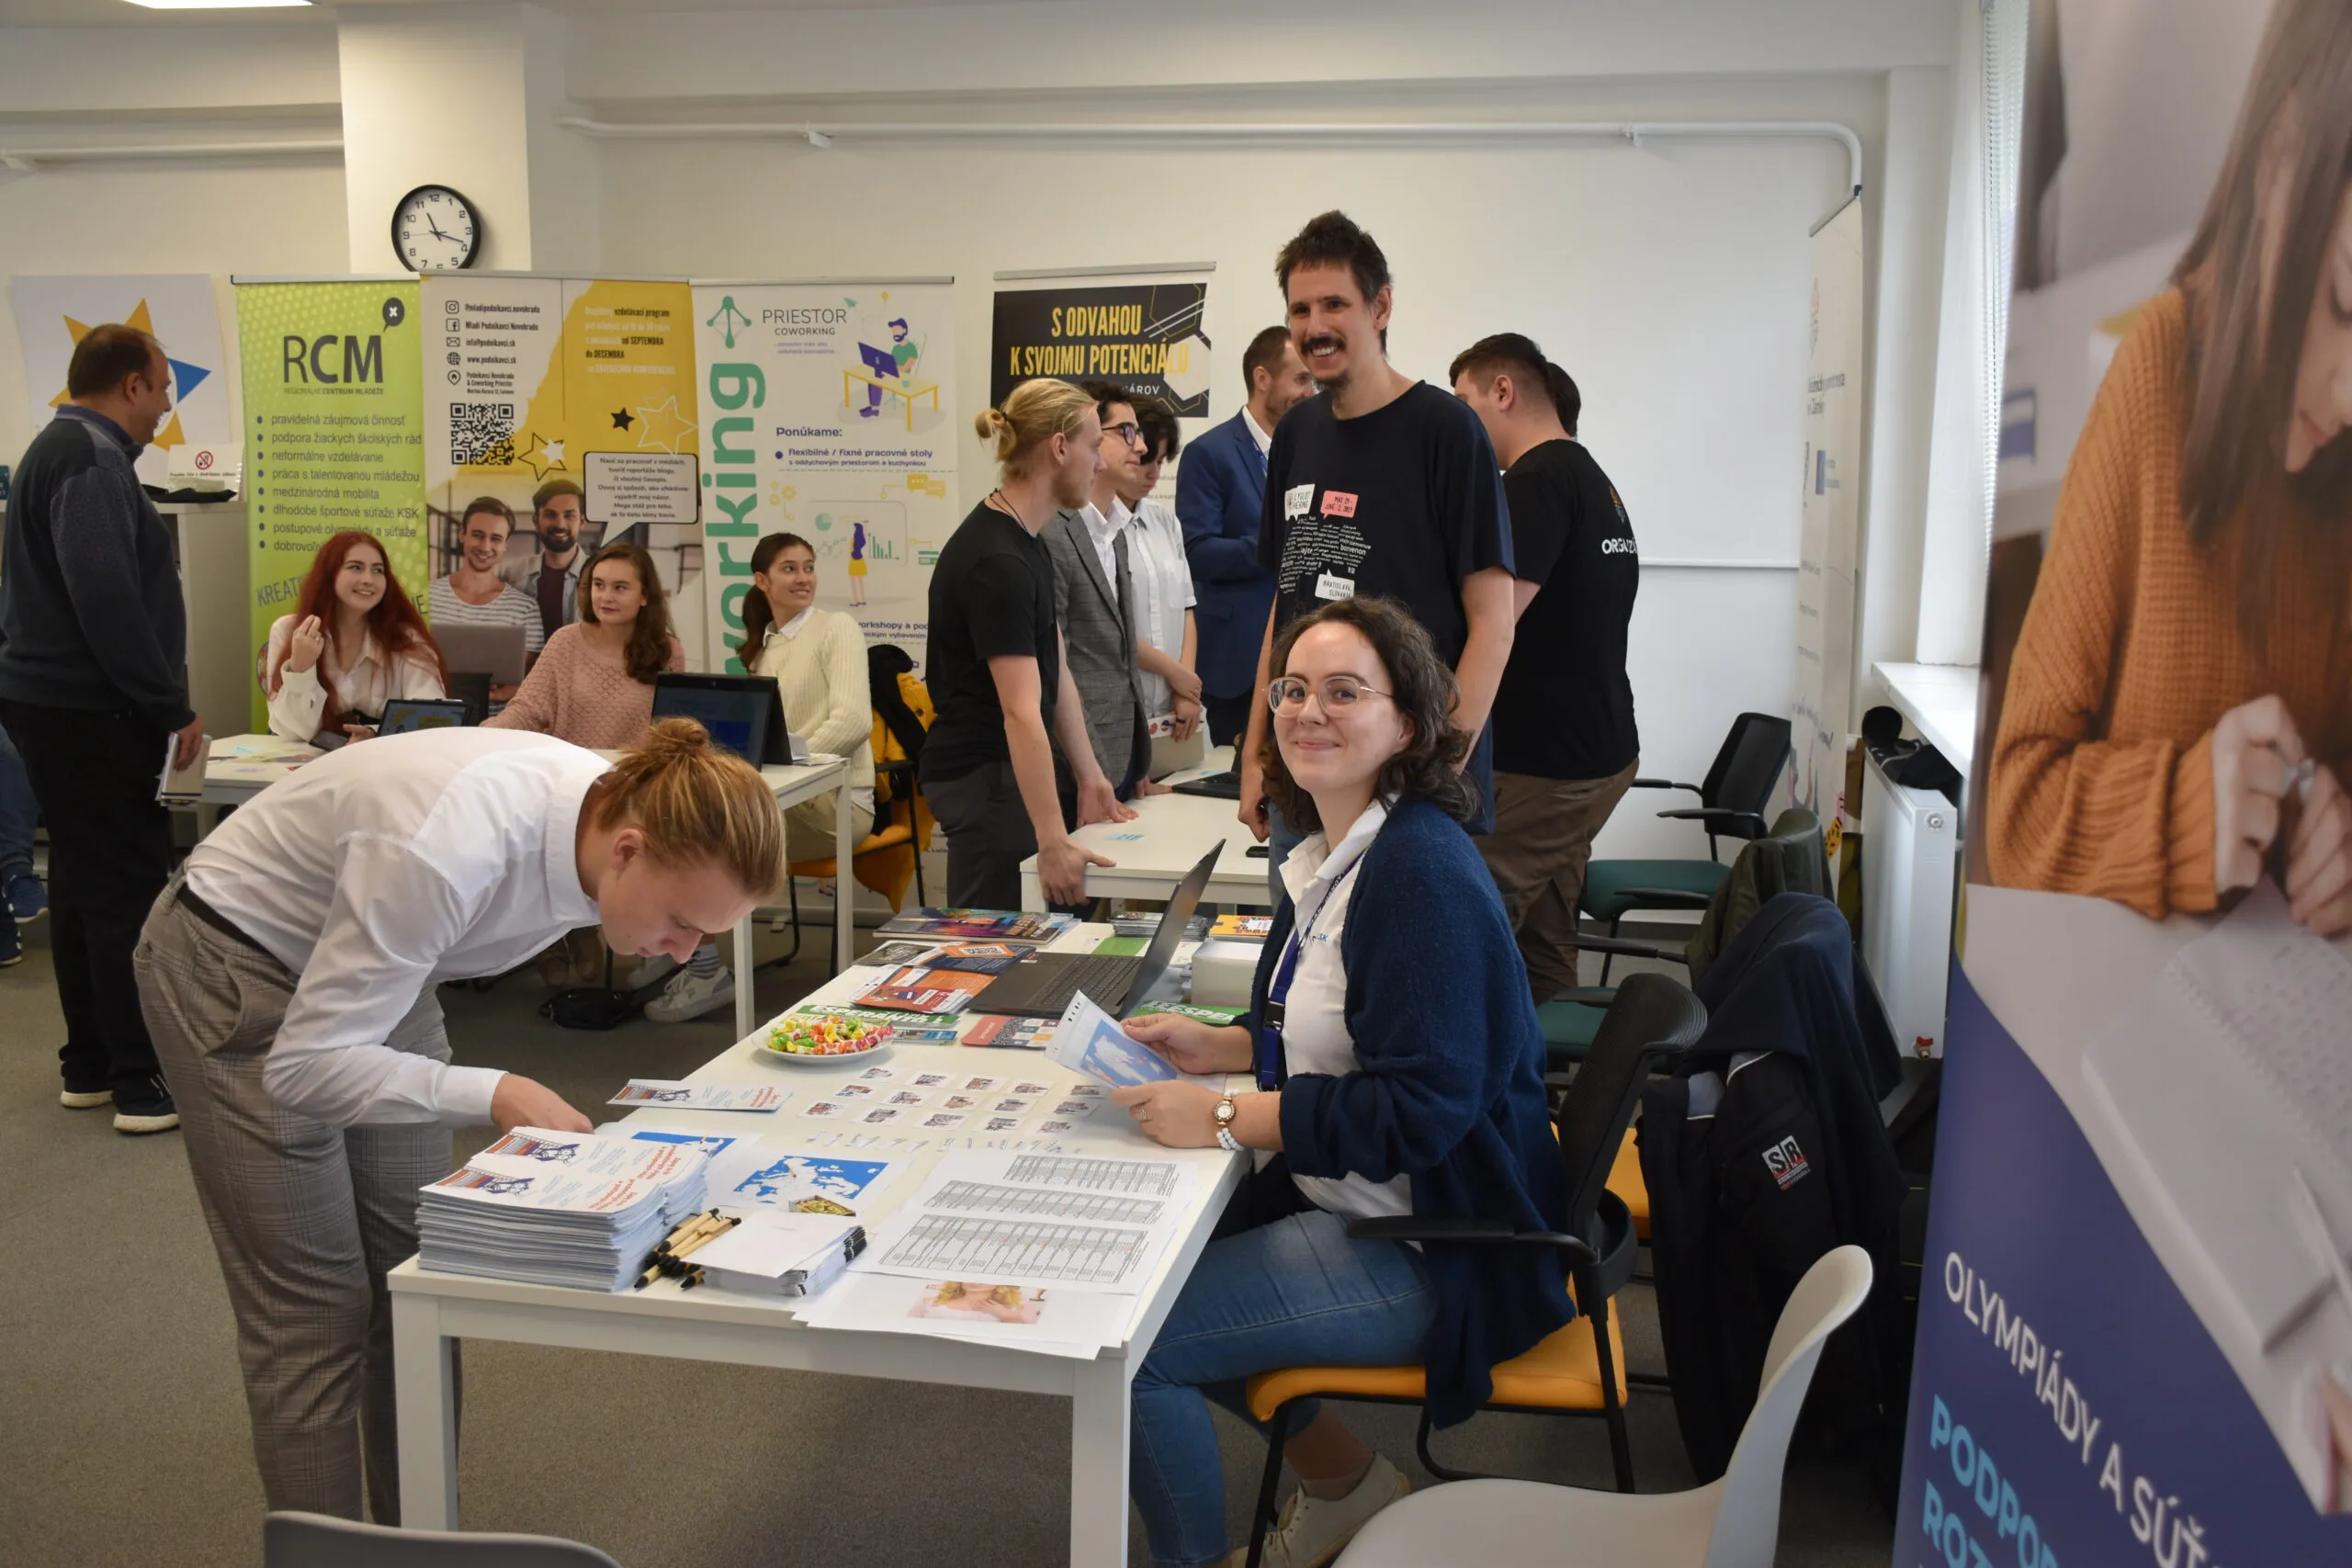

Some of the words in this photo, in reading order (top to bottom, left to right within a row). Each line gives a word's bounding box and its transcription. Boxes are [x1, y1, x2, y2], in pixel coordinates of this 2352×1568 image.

[429, 194, 440, 202] 12
[415, 200, 424, 209] 11
[405, 214, 416, 223] 10
[458, 209, 466, 219] 2
[402, 231, 410, 240] 9
[465, 227, 472, 235] 3
[409, 248, 416, 256] 8
[460, 243, 468, 252] 4
[421, 259, 428, 268] 7
[451, 257, 458, 265] 5
[645, 310, 670, 319] program
[763, 309, 847, 323] PRIESTOR
[1051, 307, 1062, 337] S
[1066, 305, 1142, 337] ODVAHOU
[775, 327, 835, 336] COWORKING
[621, 336, 629, 344] od
[630, 336, 664, 345] SEPTEMBRA
[585, 349, 593, 358] do
[594, 349, 625, 358] DECEMBRA
[1011, 346, 1020, 376] K
[1023, 344, 1085, 376] SVOJMU
[1089, 337, 1190, 376] POTENCIÁLU
[283, 334, 383, 384] RCM
[322, 387, 354, 395] CENTRUM
[271, 414, 321, 426] pravidelná
[323, 413, 368, 427] záujmová
[371, 413, 406, 425] činnosť
[776, 426, 842, 437] Ponúkame:
[272, 433, 311, 445] podpora
[405, 433, 422, 445] rád
[272, 449, 324, 461] neformálne
[327, 450, 384, 462] vzdelávanie
[788, 447, 829, 457] flexibilné
[839, 448, 862, 457] fixné
[865, 449, 908, 458] pracovné
[910, 449, 933, 458] stoly
[795, 458, 839, 467] oddychovým
[842, 459, 880, 468] priestorom
[888, 459, 926, 468] kuchynkou
[273, 469, 300, 480] práca
[311, 469, 370, 480] talentovanou
[373, 470, 420, 482] mládežou
[273, 487, 340, 499] medzinárodná
[343, 488, 379, 499] mobilita
[273, 505, 317, 516] dlhodobé
[320, 505, 360, 518] športové
[397, 508, 419, 519] KSK
[274, 524, 322, 536] postupové
[376, 527, 381, 536] a
[384, 525, 416, 537] súťaže
[1944, 1251, 2101, 1466] OLYMPIÁDY
[2098, 1440, 2123, 1514] A
[2129, 1474, 2222, 1568] SÚŤ
